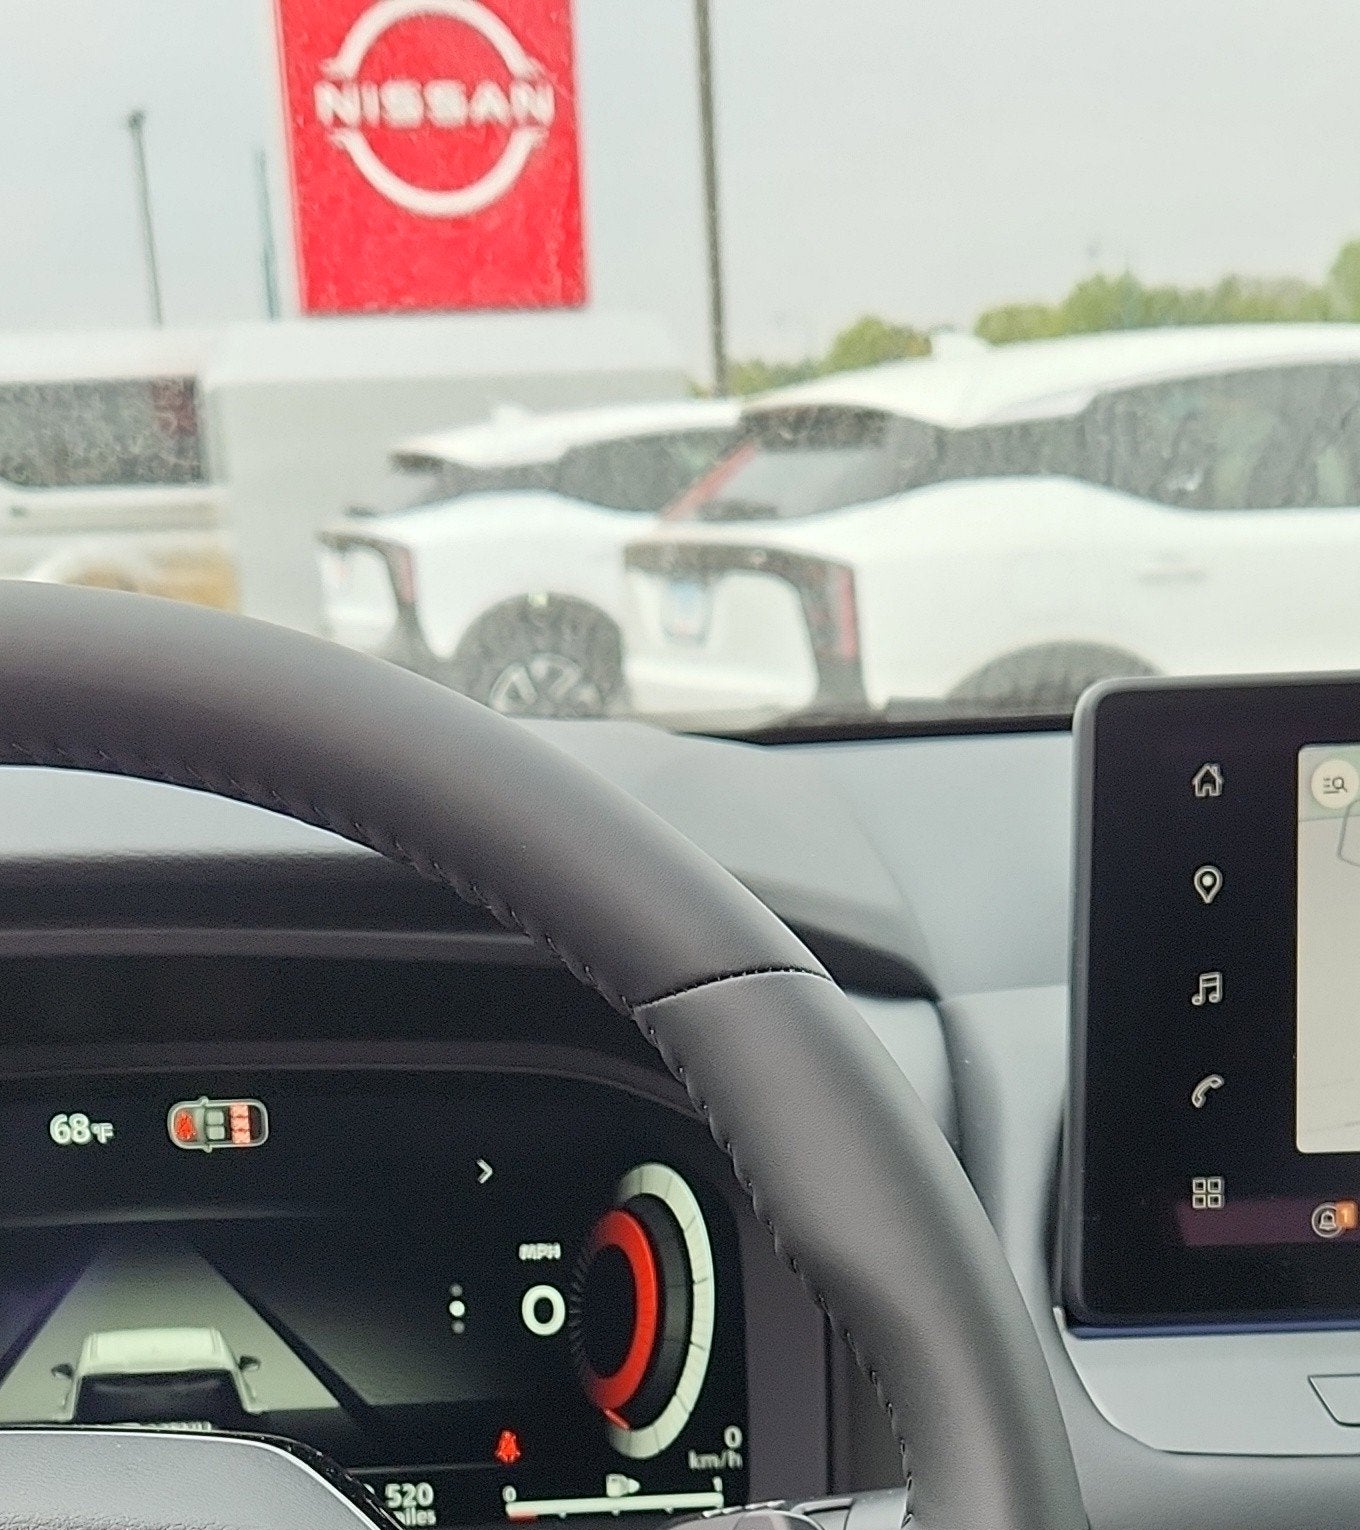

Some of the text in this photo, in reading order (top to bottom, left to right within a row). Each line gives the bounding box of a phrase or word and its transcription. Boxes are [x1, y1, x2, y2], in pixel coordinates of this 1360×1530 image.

[314, 79, 556, 129] NISSAN
[519, 1243, 561, 1260] MPH
[384, 1482, 434, 1508] 520
